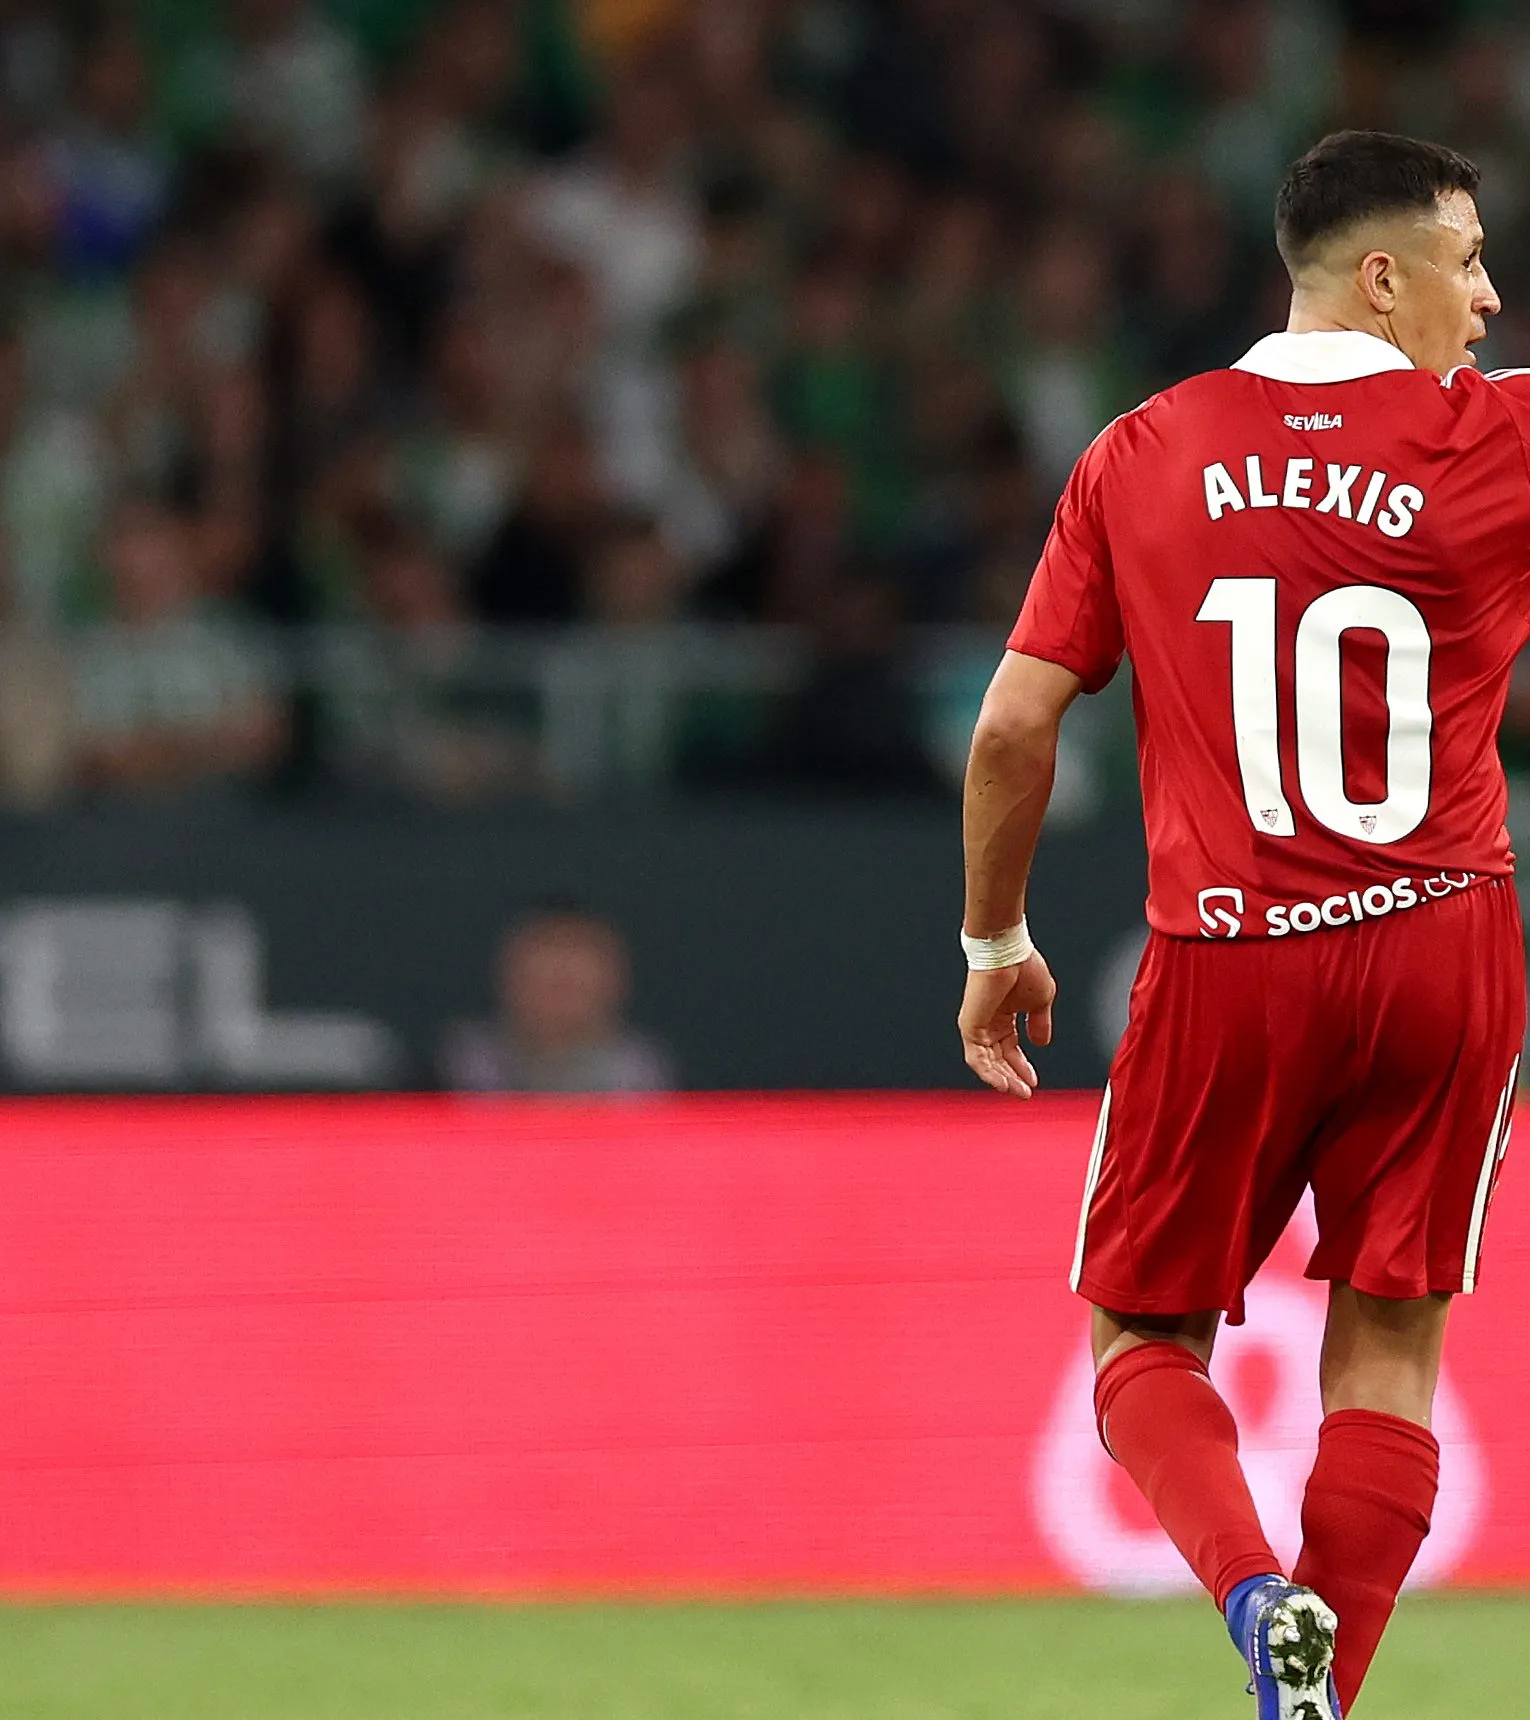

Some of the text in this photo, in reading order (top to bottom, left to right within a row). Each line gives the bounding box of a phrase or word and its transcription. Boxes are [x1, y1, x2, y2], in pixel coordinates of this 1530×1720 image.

[1283, 412, 1343, 431] SEVILLA
[1203, 455, 1425, 538] ALEXIS
[1194, 577, 1433, 844] 10
[1265, 871, 1476, 937] SOCIOS.co
